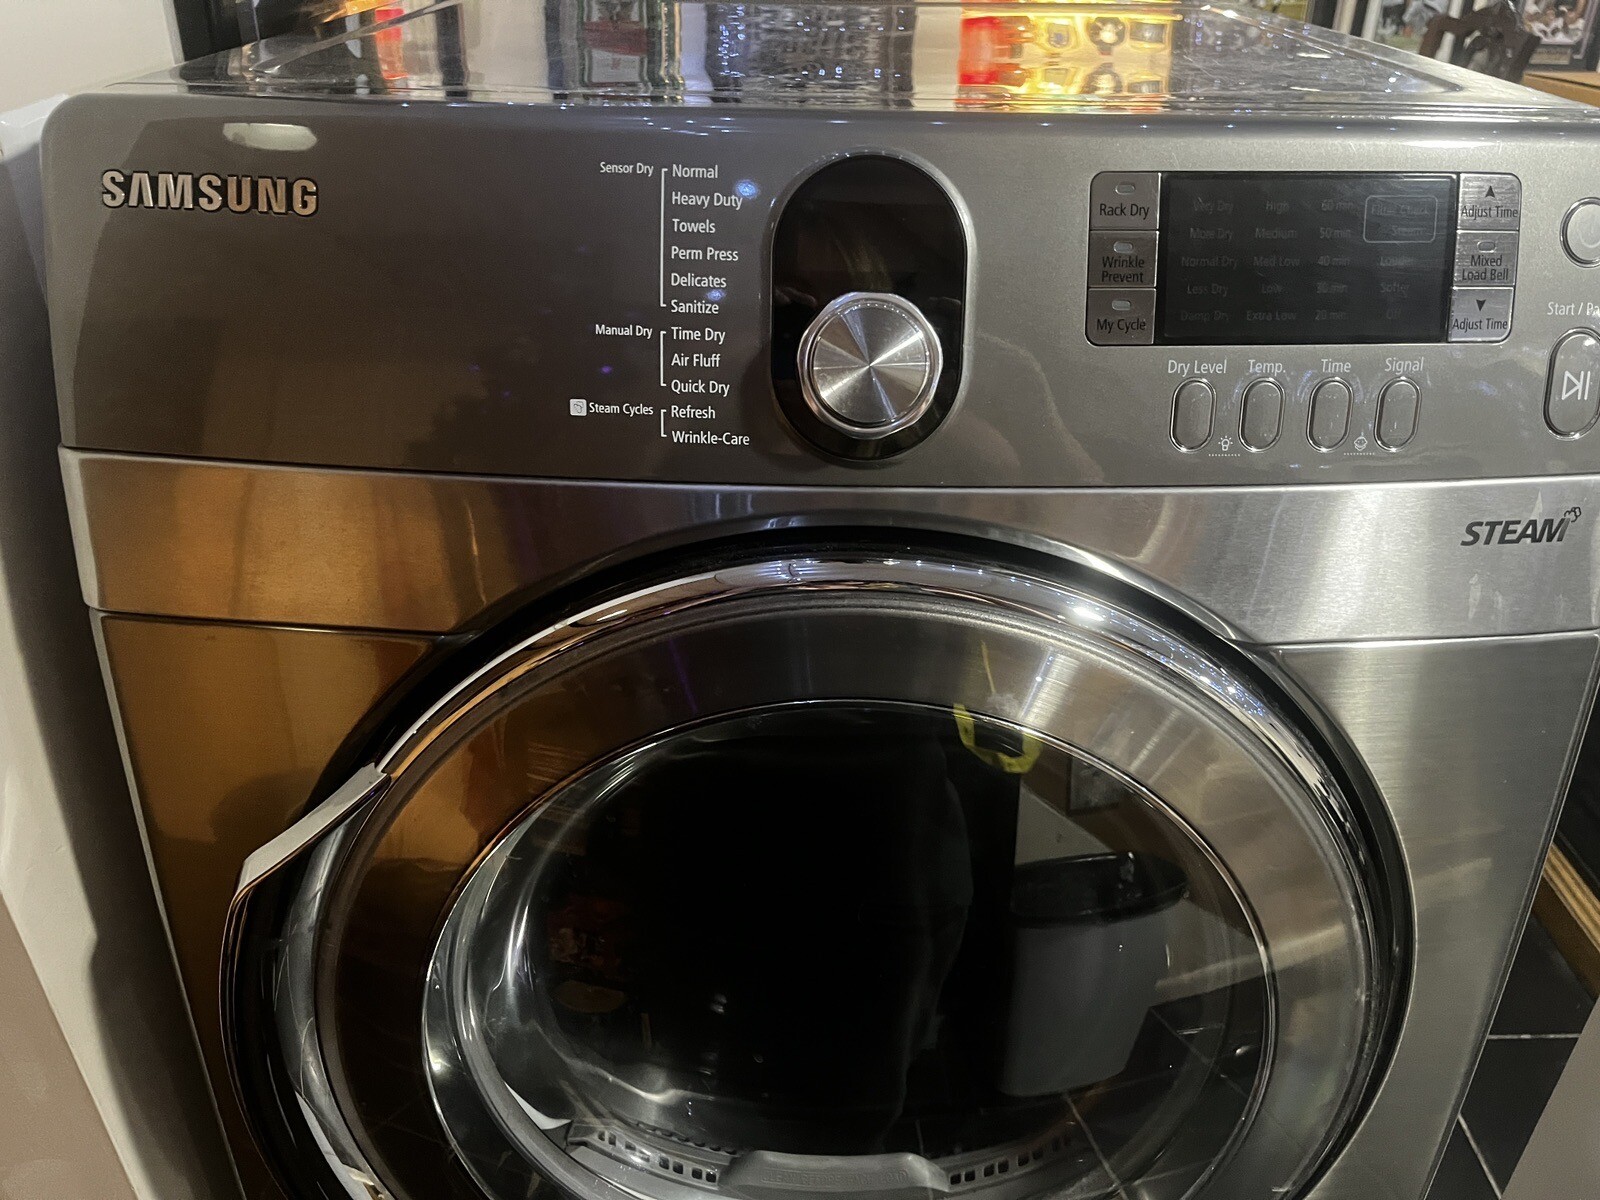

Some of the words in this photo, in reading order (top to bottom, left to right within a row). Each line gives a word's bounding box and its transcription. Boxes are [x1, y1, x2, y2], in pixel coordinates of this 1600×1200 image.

[600, 162, 634, 175] Sensor
[636, 162, 654, 177] Dry
[672, 164, 719, 179] Normal
[101, 169, 319, 217] SAMSUNG
[671, 191, 710, 208] Heavy
[713, 192, 743, 210] Duty
[1100, 203, 1126, 216] Rack
[1130, 203, 1150, 220] Dry
[1461, 205, 1493, 220] Adjust
[1495, 206, 1519, 218] Time
[672, 218, 716, 234] Towels
[671, 246, 703, 261] Perm
[706, 247, 739, 262] Press
[1470, 255, 1503, 267] Mixed
[1101, 256, 1145, 269] Wrinkle
[1221, 256, 1239, 270] Dry
[671, 272, 727, 288] Delicates
[1101, 270, 1144, 283] Prevent
[1462, 269, 1488, 281] Load
[1490, 268, 1509, 281] Bell
[1211, 283, 1229, 298] Dry
[671, 299, 720, 315] Sanitize
[1547, 301, 1576, 316] Start
[1577, 302, 1584, 316] /
[595, 324, 633, 337] Manual
[635, 325, 653, 340] Dry
[1096, 318, 1114, 333] My
[1117, 318, 1146, 333] Cycle
[1452, 318, 1483, 333] Adjust
[1485, 318, 1508, 331] Time
[671, 326, 701, 341] Time
[704, 328, 726, 345] Dry
[671, 353, 690, 367] Air
[693, 353, 721, 368] Fluff
[1167, 359, 1191, 377] Dry
[1194, 359, 1228, 374] Level
[1249, 359, 1287, 377] Temp.
[1321, 358, 1352, 373] Time
[1384, 356, 1425, 376] Signal
[671, 379, 705, 395] Quick
[709, 381, 730, 398] Dry
[589, 402, 620, 415] Steam
[622, 403, 654, 417] Cycles
[671, 405, 716, 420] Refresh
[671, 430, 750, 446] Wrinkle-Care
[1460, 518, 1571, 546] STEAM
